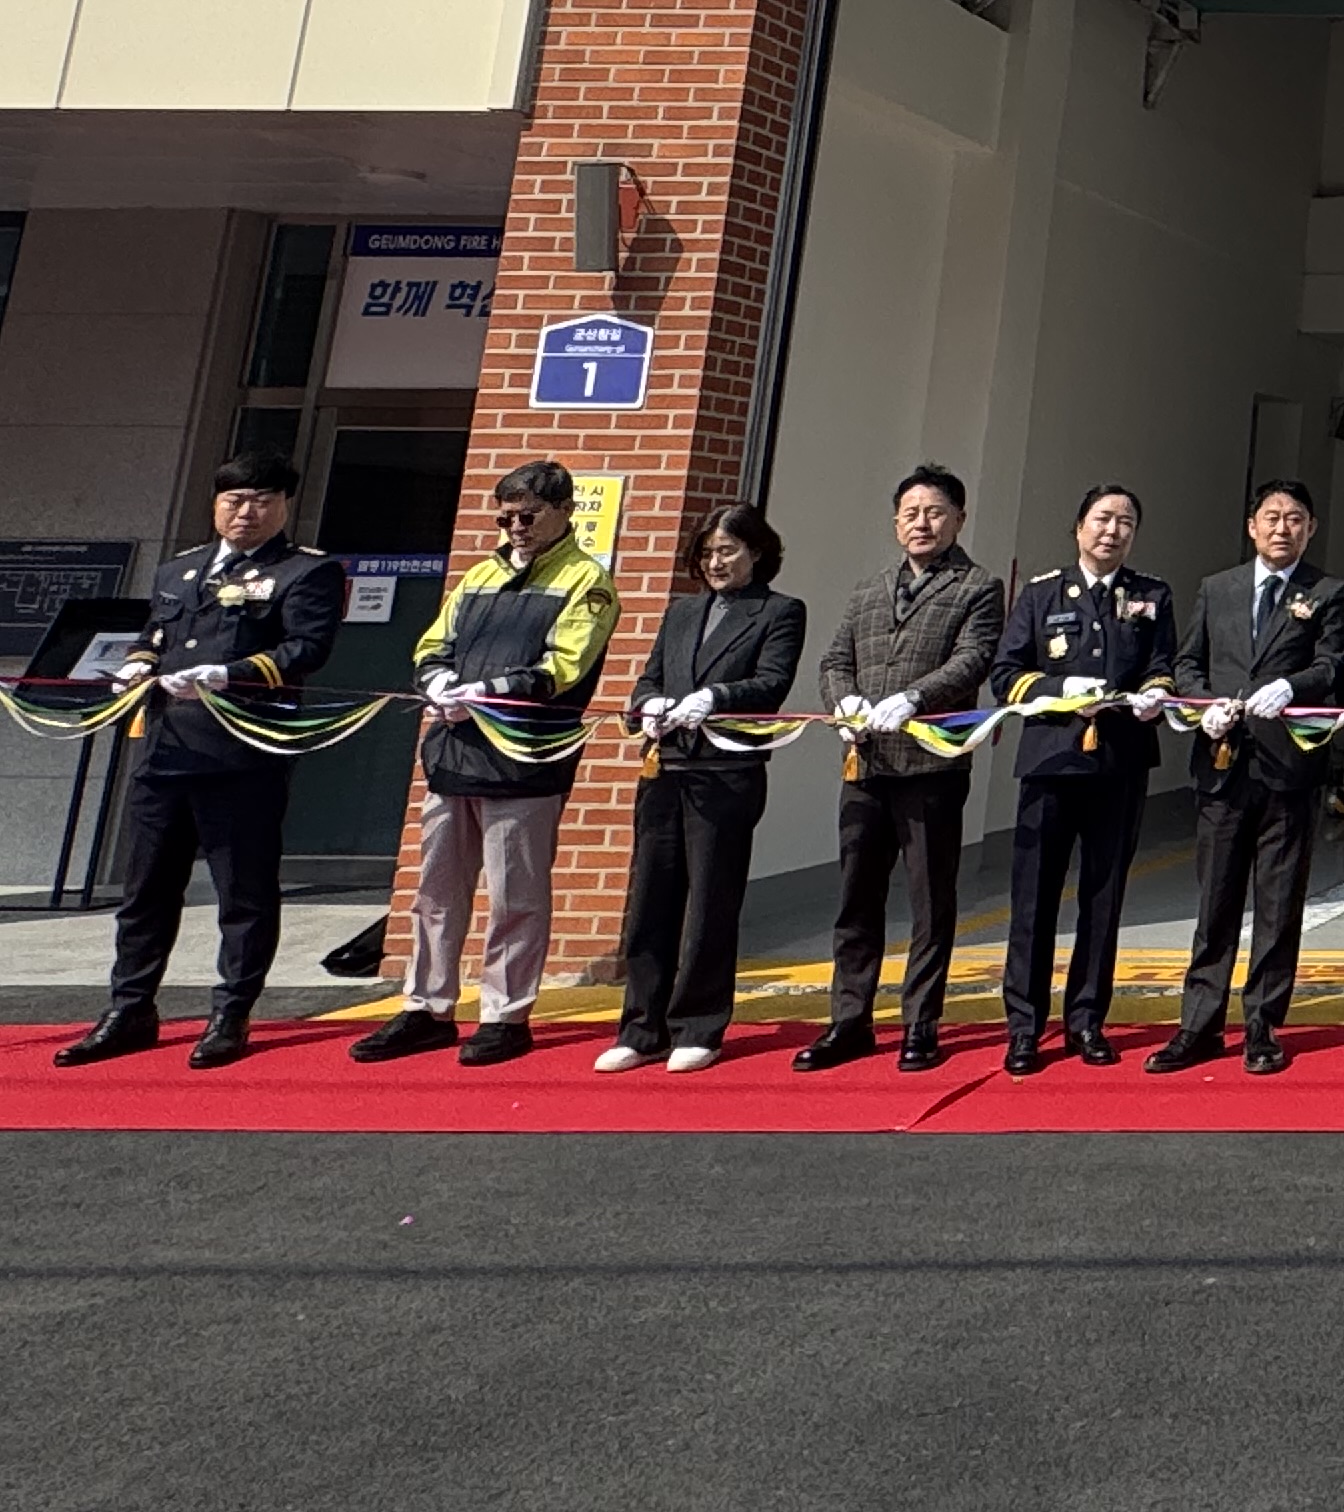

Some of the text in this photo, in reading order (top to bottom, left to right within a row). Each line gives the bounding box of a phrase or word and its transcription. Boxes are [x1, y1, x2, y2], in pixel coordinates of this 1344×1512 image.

[368, 234, 457, 250] GEUMDONG
[459, 234, 489, 250] FIRE
[361, 279, 439, 317] 함께
[582, 361, 598, 398] 1
